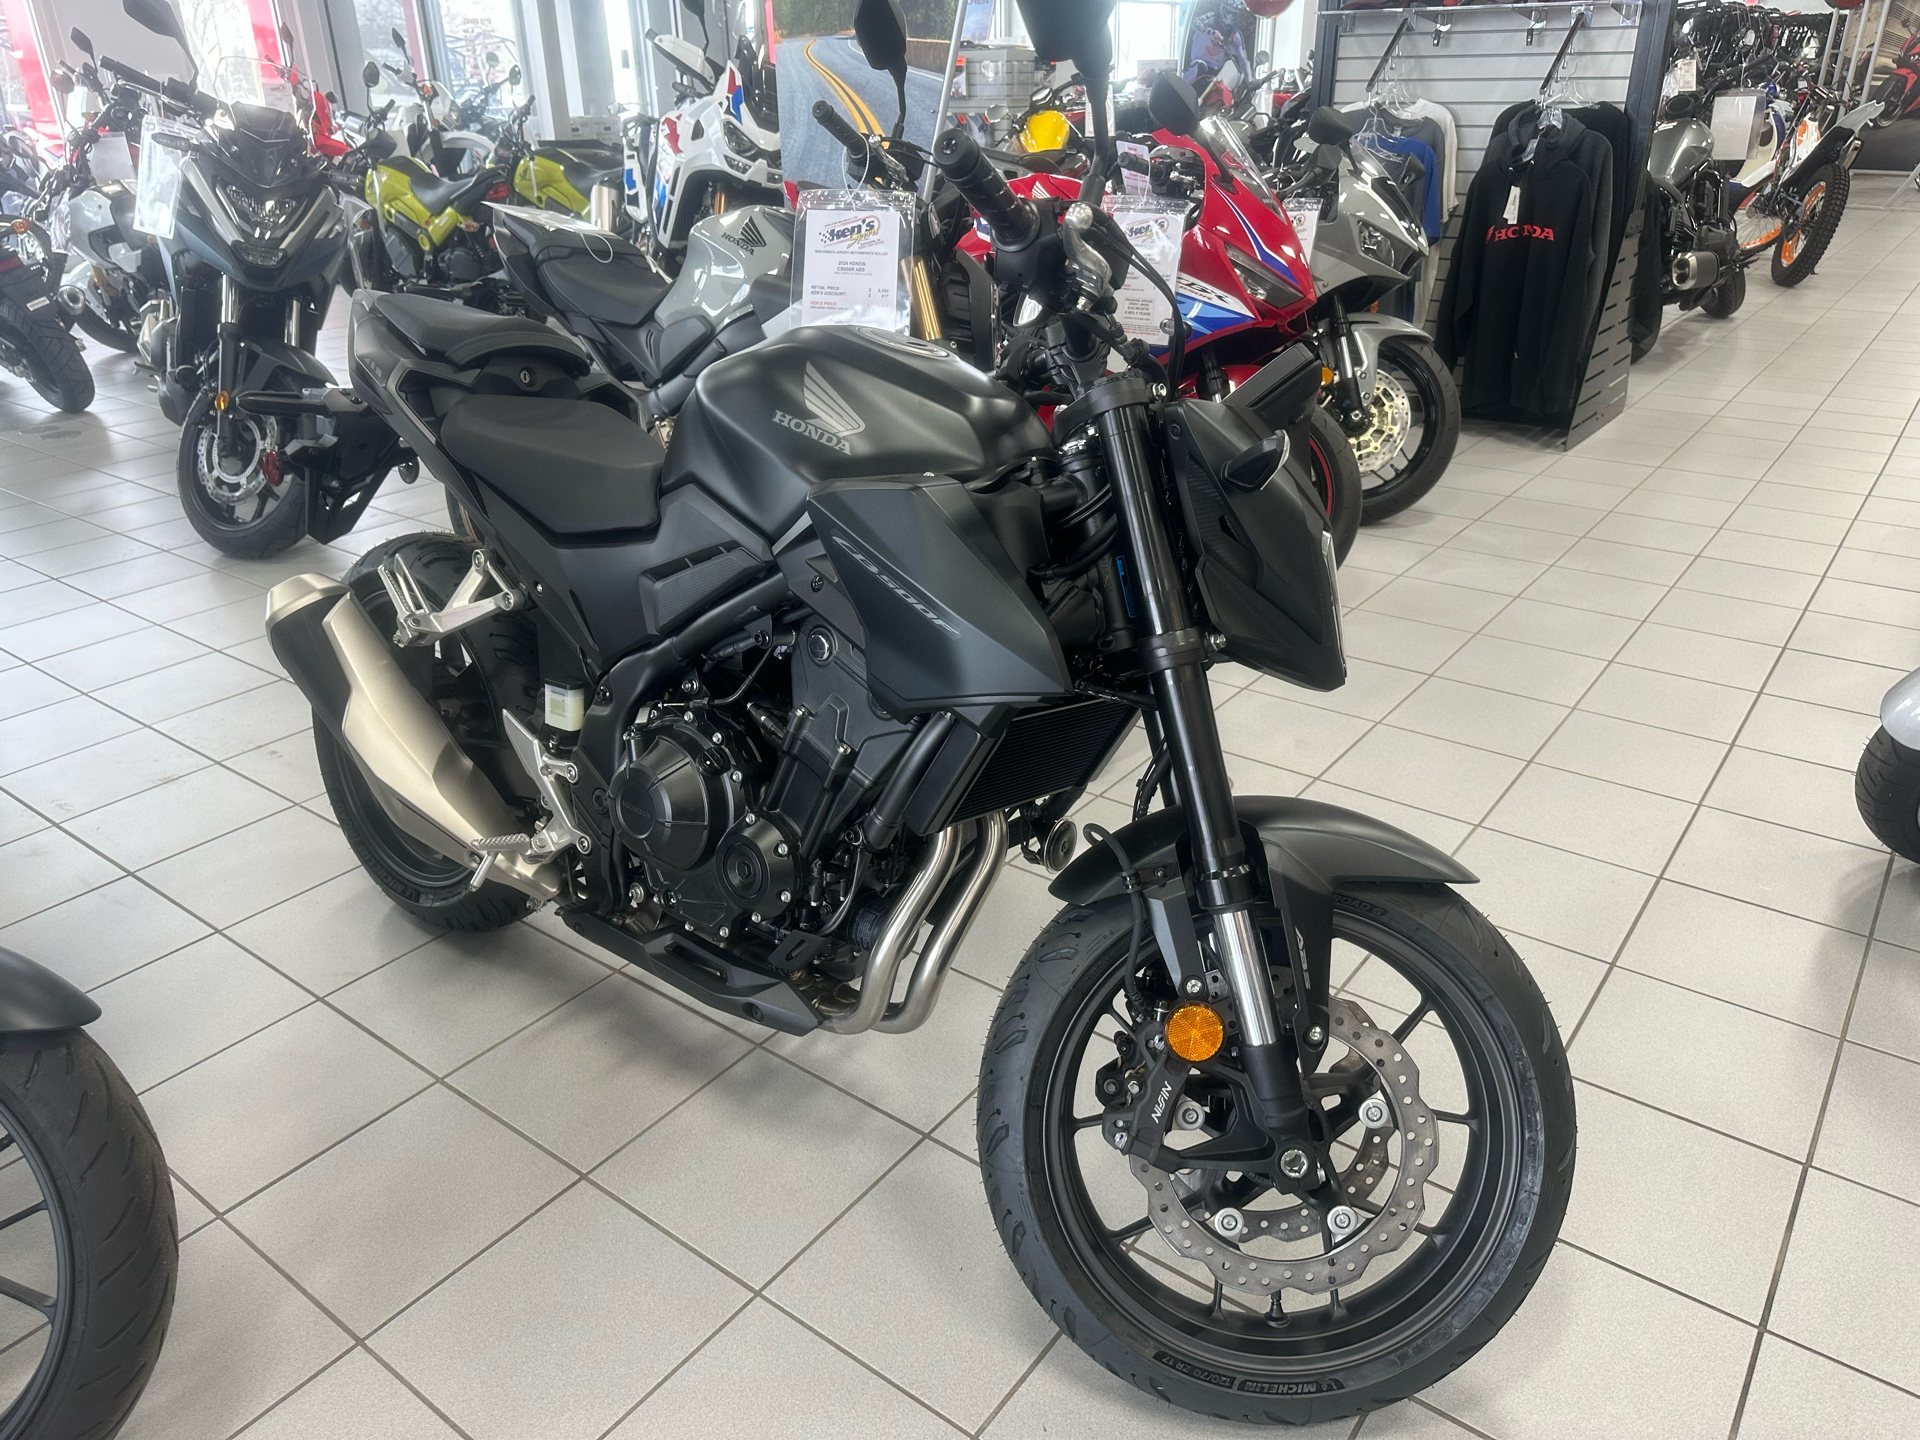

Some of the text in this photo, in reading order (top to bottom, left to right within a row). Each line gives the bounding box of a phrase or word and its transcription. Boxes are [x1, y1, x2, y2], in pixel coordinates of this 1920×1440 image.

[829, 218, 875, 242] ken's
[1494, 224, 1555, 242] HONDA
[721, 232, 755, 256] HONDA
[772, 410, 853, 456] HONDA
[1333, 894, 1371, 910] ROAD
[1151, 1080, 1172, 1124] NISSIN
[1161, 1356, 1232, 1387] 120/70 ZR 17
[1243, 1380, 1317, 1394] MICHELIN
